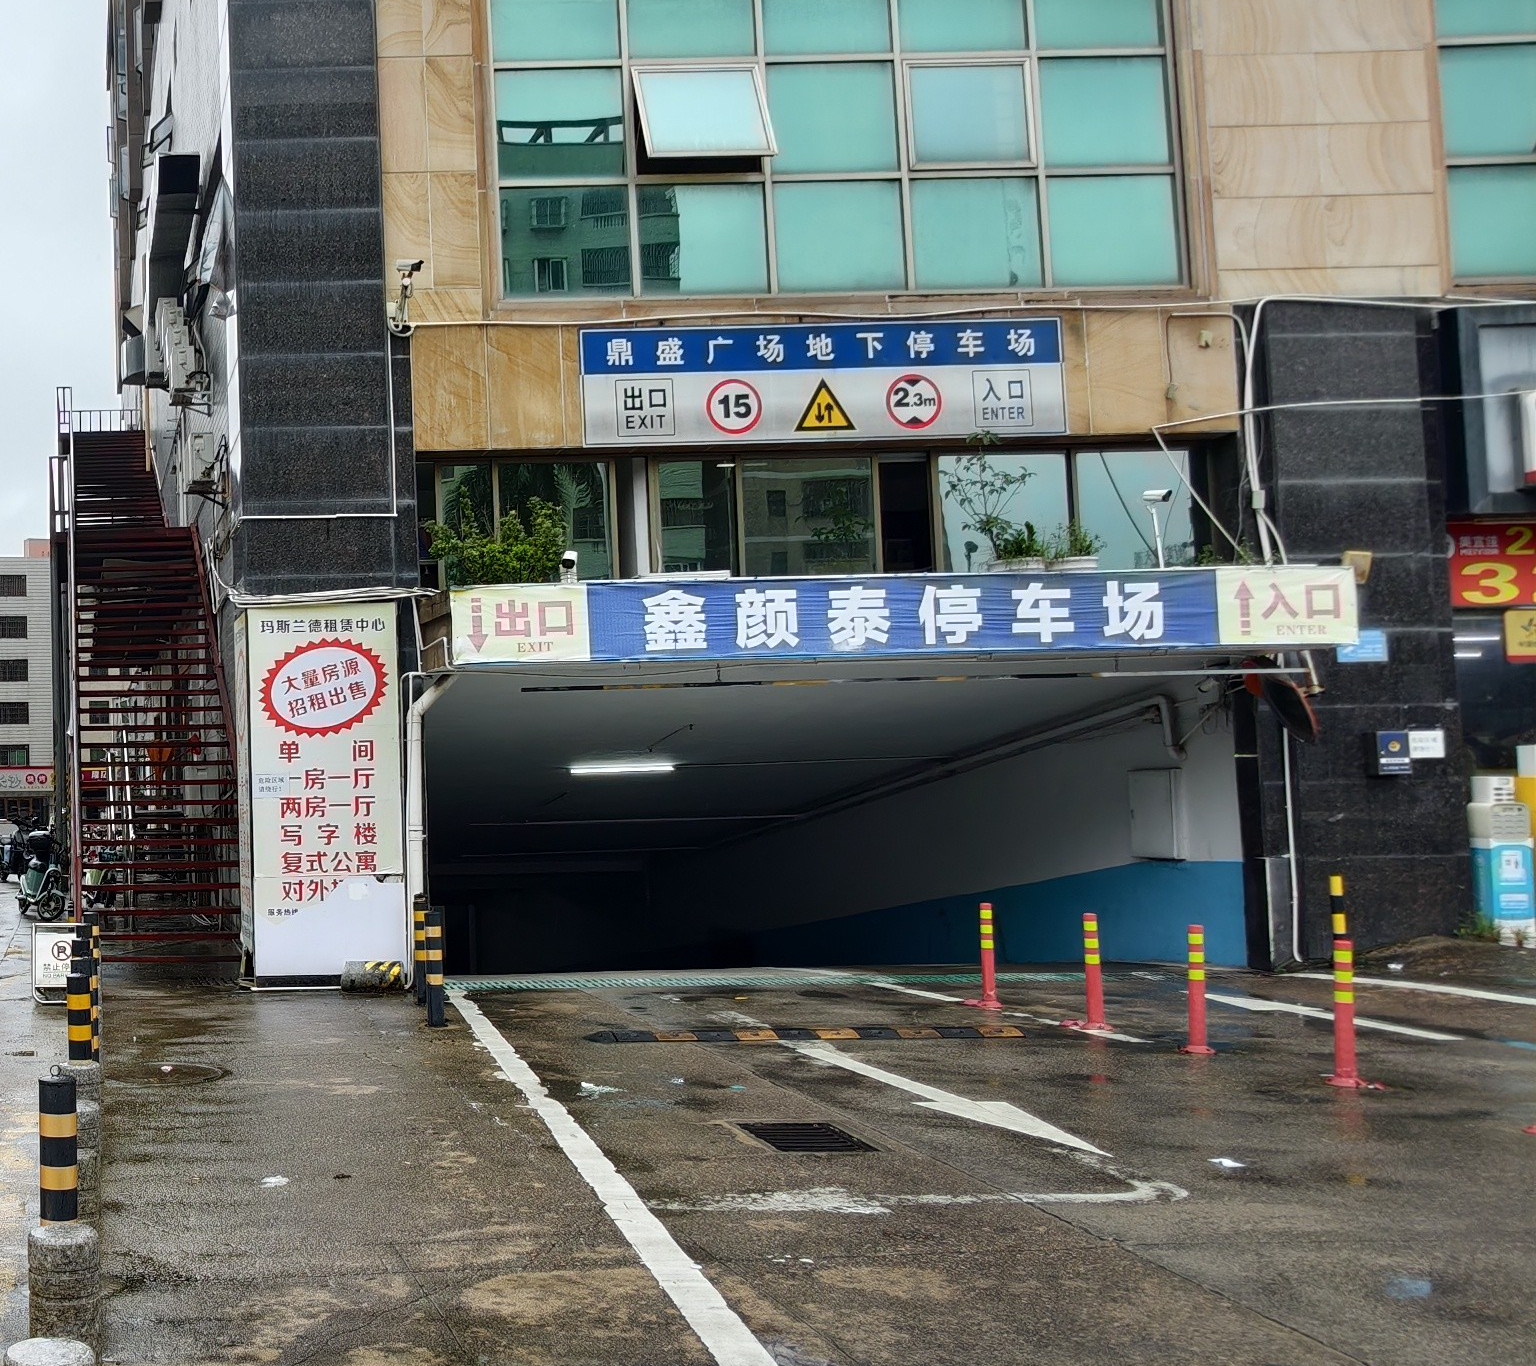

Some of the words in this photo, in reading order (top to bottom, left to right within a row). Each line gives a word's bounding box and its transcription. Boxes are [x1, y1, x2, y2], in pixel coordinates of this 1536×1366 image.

[605, 328, 1036, 366] 鼎盛广场地下停车场
[623, 386, 667, 412] 出口
[893, 387, 937, 408] 2.3m
[981, 377, 1024, 403] 入口
[717, 393, 752, 419] 15
[982, 406, 1025, 421] ENTER
[625, 414, 666, 430] EXIT
[1261, 582, 1341, 620] 入口
[260, 617, 386, 634] 玛斯兰德租赁中心
[494, 598, 573, 638] 出口
[642, 579, 1165, 652] 鑫颜泰停车场
[1276, 624, 1328, 636] ENTER
[517, 641, 554, 653] EXIT
[280, 657, 362, 695] 大量房源
[287, 680, 367, 718] 招租出售
[279, 795, 376, 819] 两房一厅
[280, 822, 378, 846] 写字楼
[280, 850, 378, 874] 复式公寓
